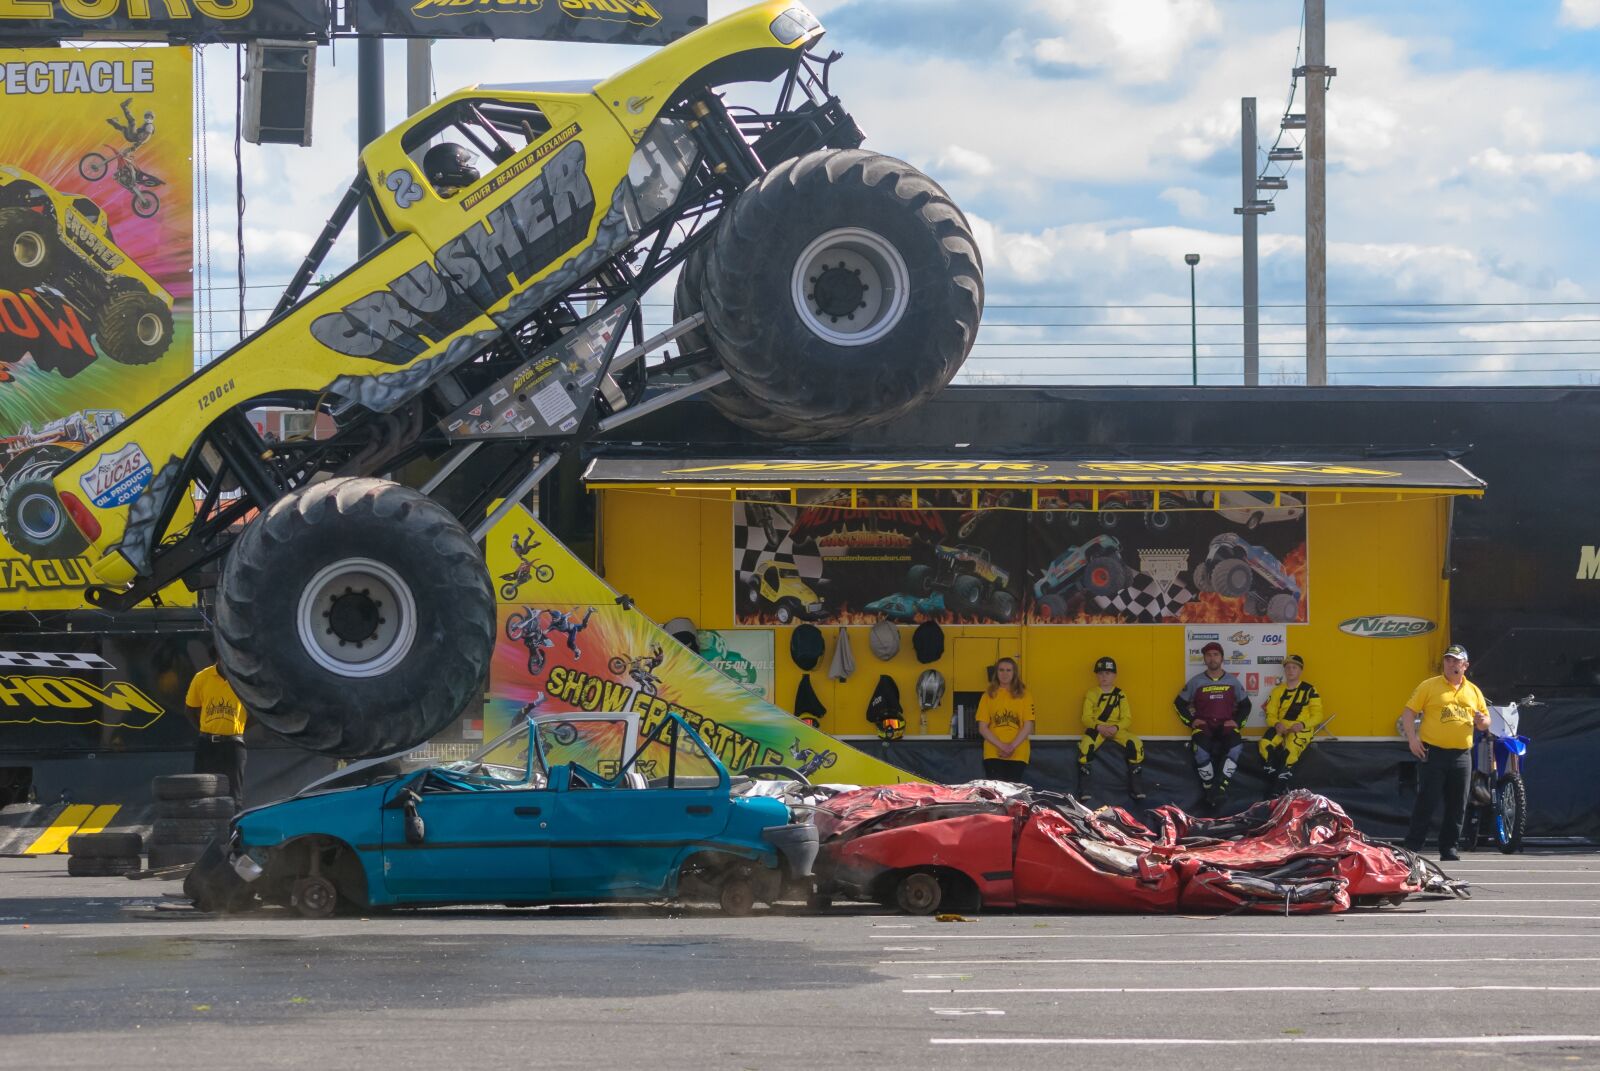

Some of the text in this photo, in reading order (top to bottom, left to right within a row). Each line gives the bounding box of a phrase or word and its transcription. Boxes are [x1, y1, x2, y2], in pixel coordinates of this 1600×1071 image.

[0, 60, 154, 94] ECTACLE
[464, 185, 491, 208] DRIVER
[536, 124, 578, 159] ALEXANDRE
[310, 141, 594, 356] CRUSHER
[96, 452, 141, 496] LUCAS
[96, 466, 152, 507] OIL PRODUCTS
[1262, 634, 1283, 643] IGOL
[1352, 618, 1426, 633] Nitro
[546, 665, 632, 713] SHOW
